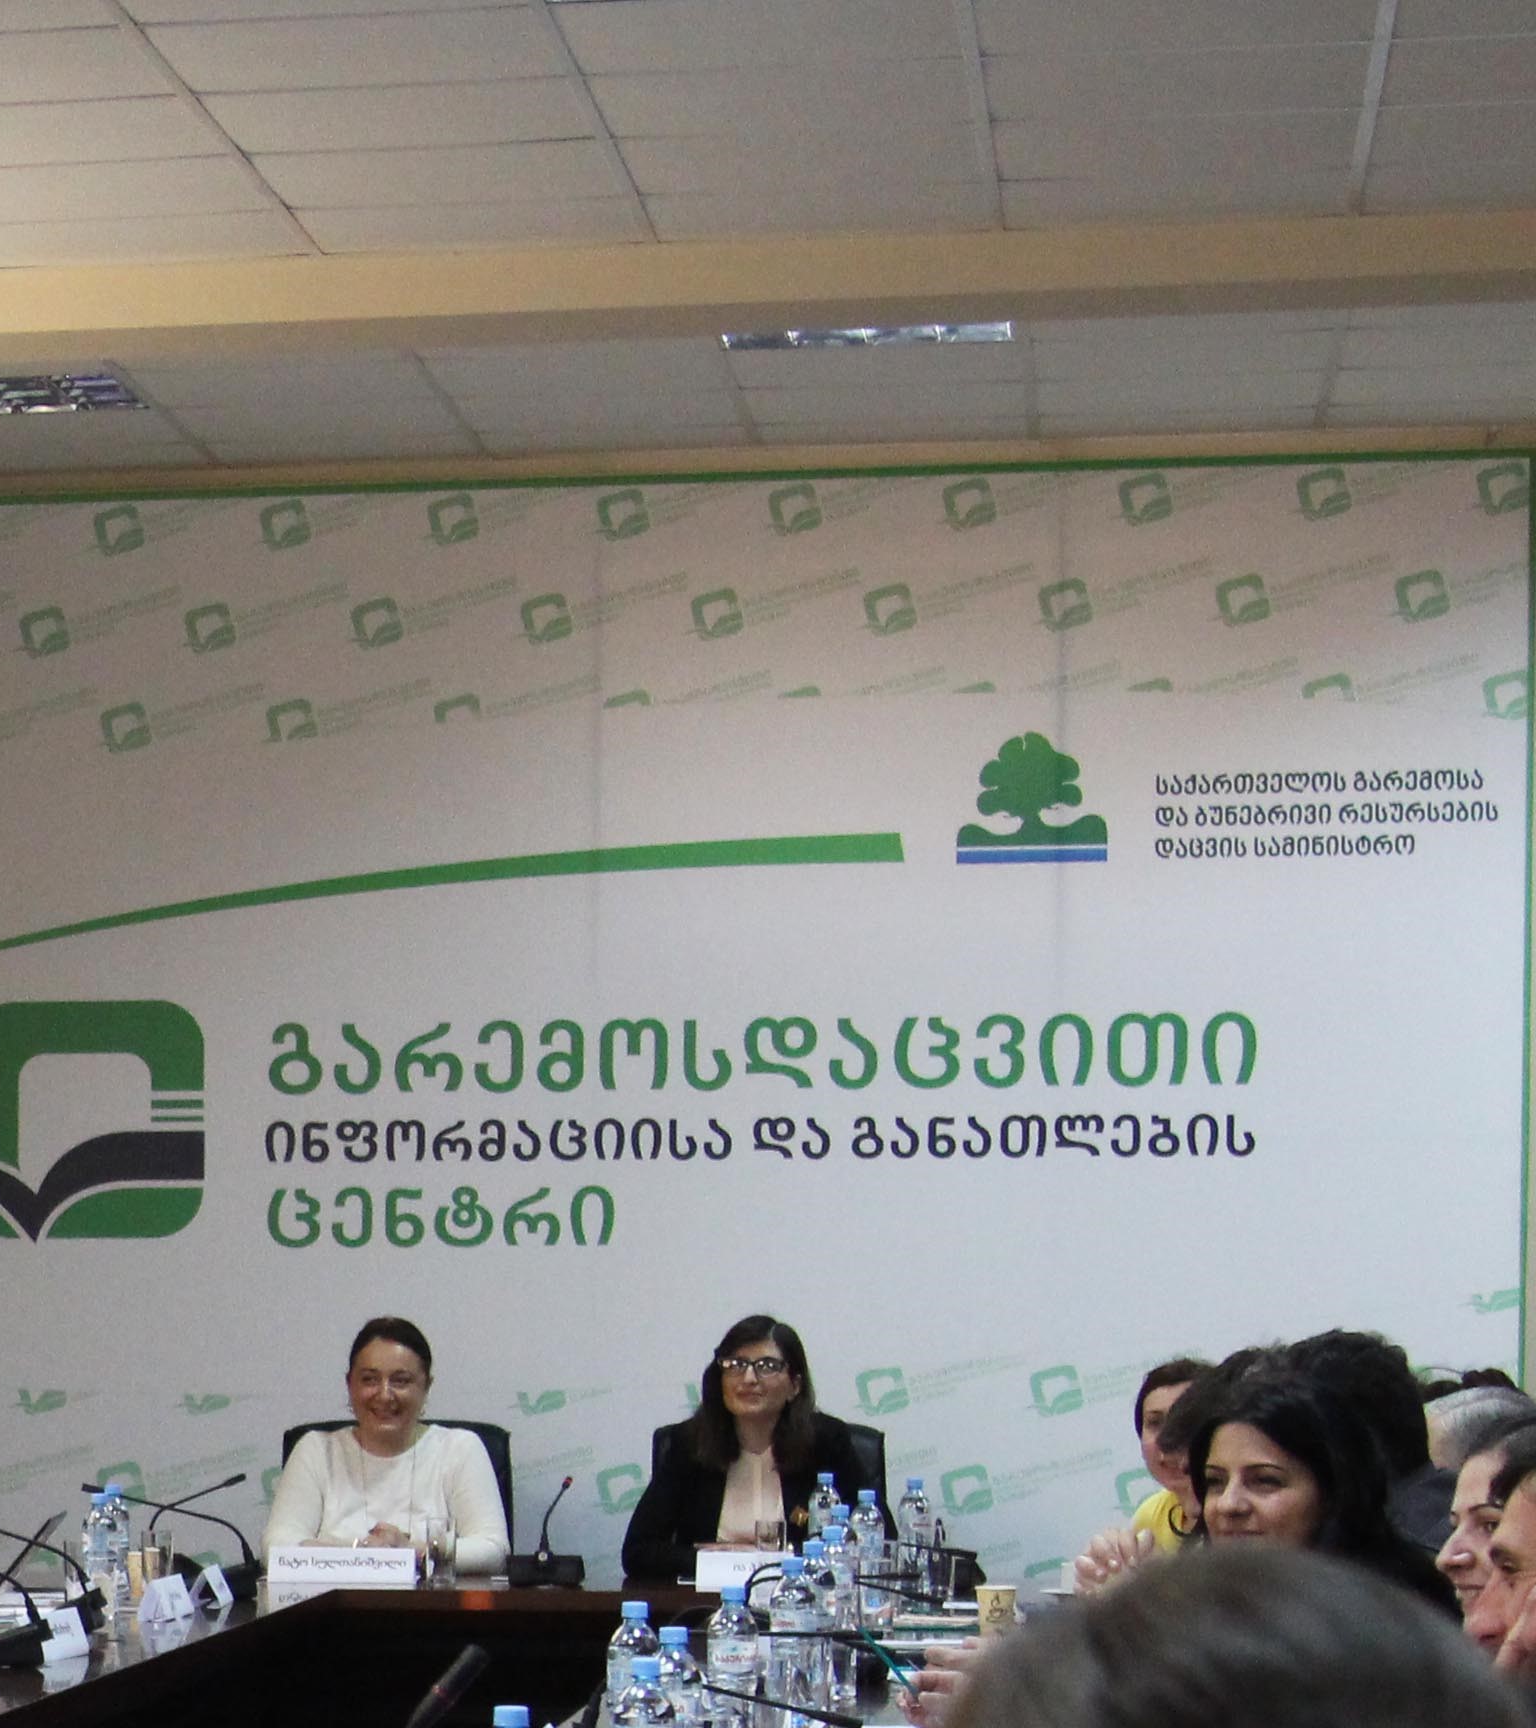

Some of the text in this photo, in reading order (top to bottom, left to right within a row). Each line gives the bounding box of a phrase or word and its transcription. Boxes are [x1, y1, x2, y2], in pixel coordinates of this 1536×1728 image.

[1155, 769, 1484, 796] საქართველოს გარემოსა
[1155, 801, 1499, 827] და ბუნებრივი რესურსების
[1155, 835, 1416, 859] დაცვის სამინისტრო
[268, 1011, 1258, 1095] გარემოსდაცვითი
[264, 1113, 1256, 1163] ინფორმაციისა და განათლების
[267, 1184, 616, 1248] ცენტრი
